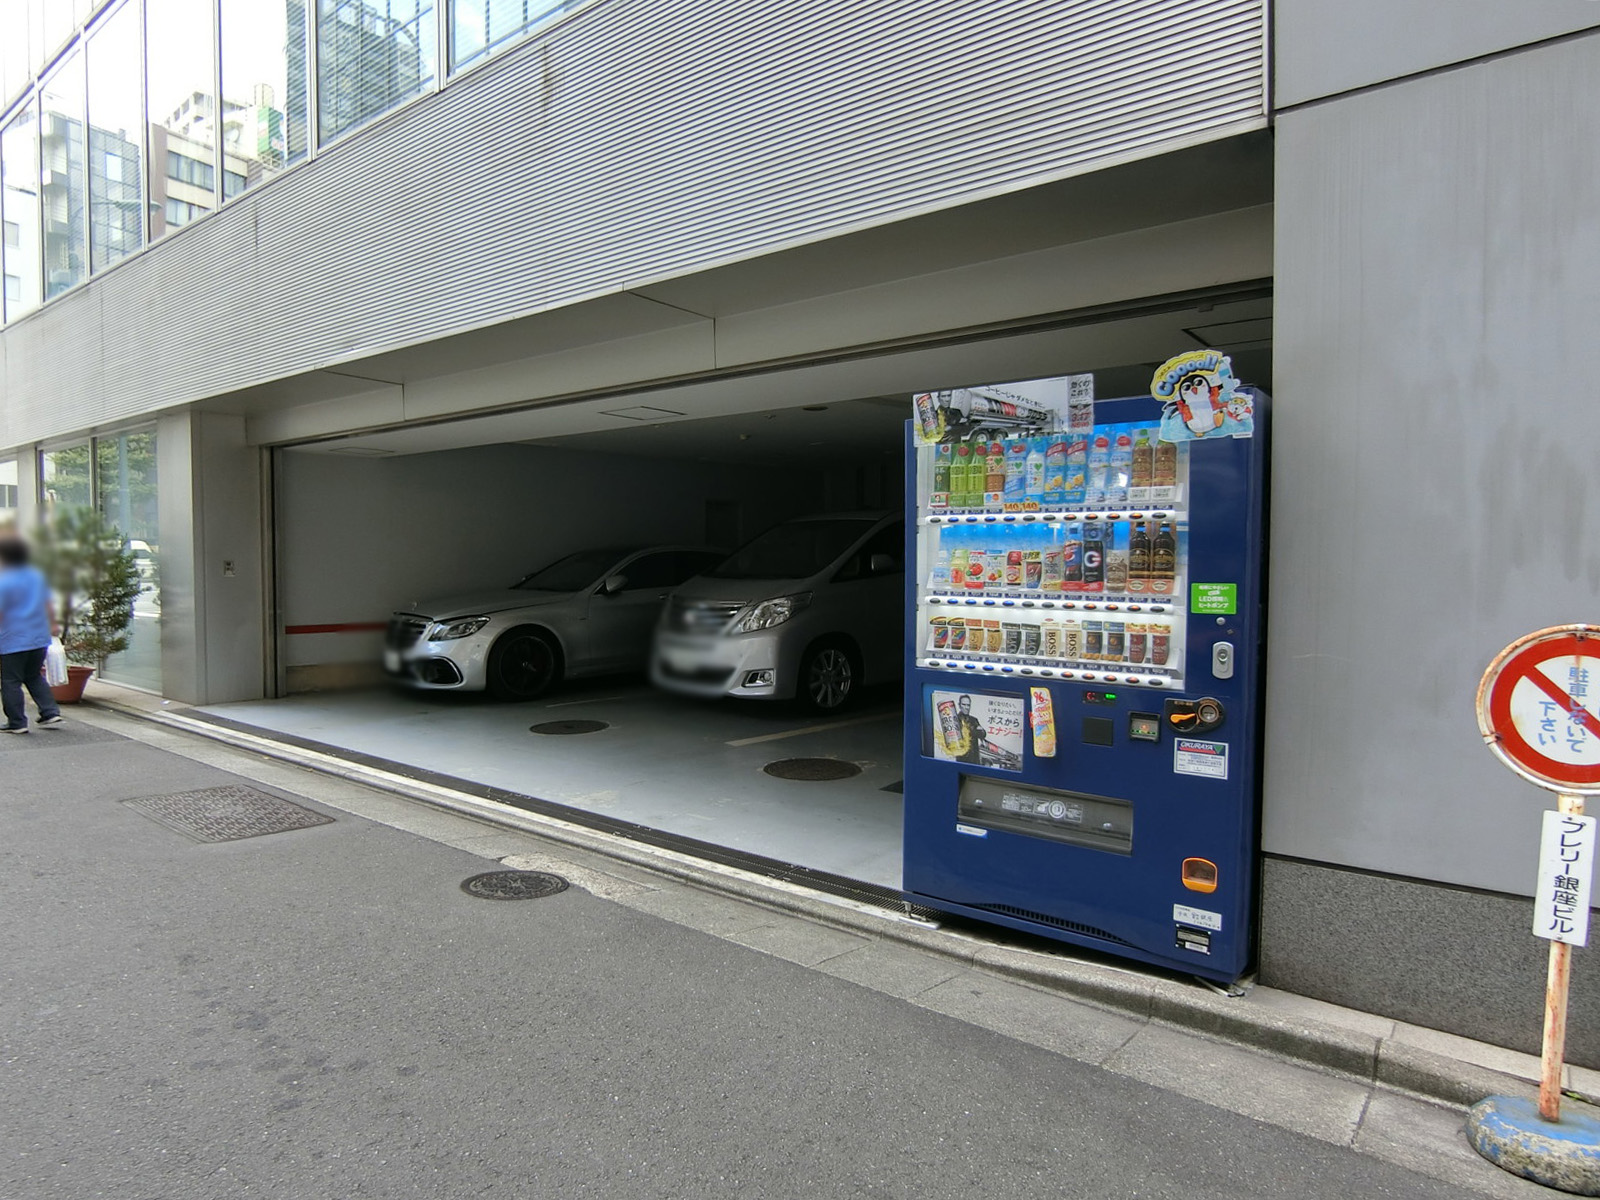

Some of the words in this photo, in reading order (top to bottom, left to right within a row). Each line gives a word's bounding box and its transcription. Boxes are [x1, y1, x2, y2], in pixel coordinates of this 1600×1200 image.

[1004, 502, 1020, 511] 140
[1021, 502, 1038, 511] 140
[1048, 631, 1056, 655] BOSS
[1069, 633, 1077, 657] BOSS
[987, 715, 1020, 728] ボスから
[1538, 700, 1556, 746] 下さい
[1180, 741, 1213, 751] OKURAYA
[1548, 820, 1587, 933] プレリー銀座ビル
